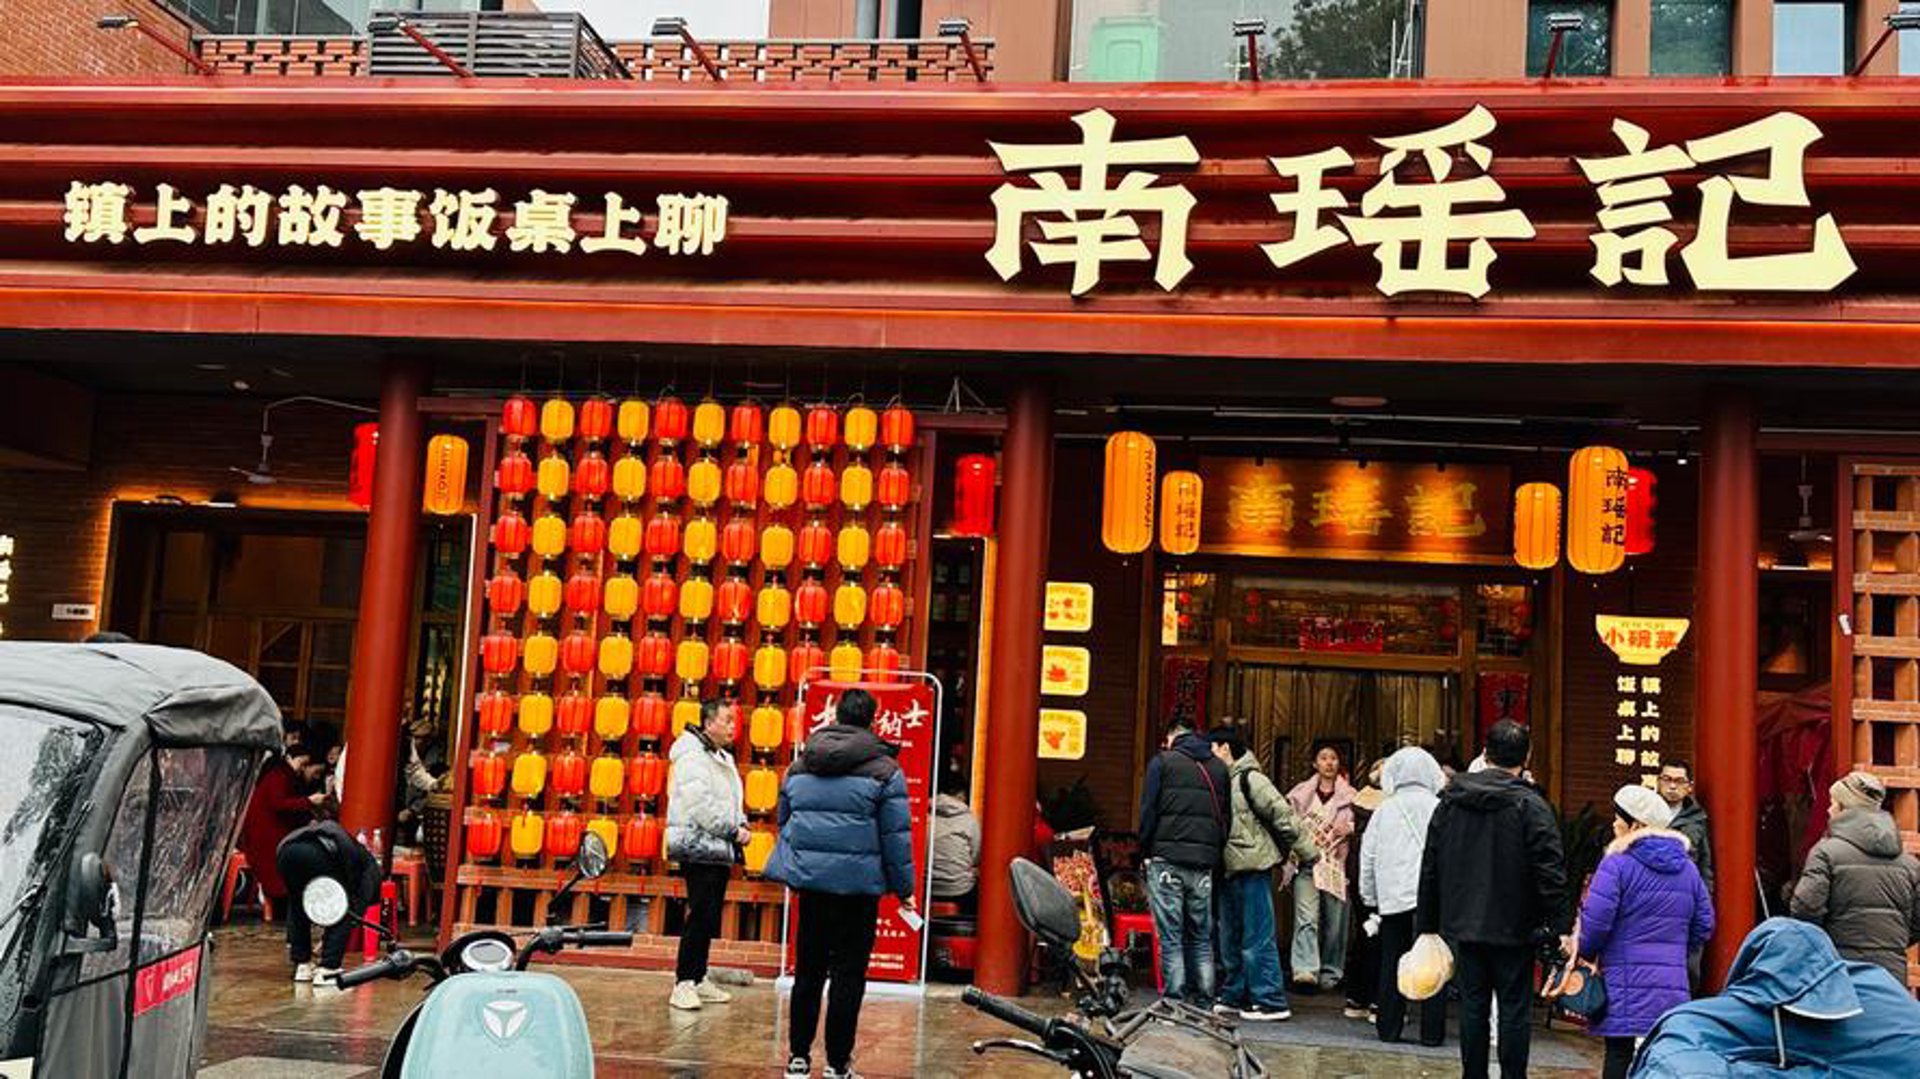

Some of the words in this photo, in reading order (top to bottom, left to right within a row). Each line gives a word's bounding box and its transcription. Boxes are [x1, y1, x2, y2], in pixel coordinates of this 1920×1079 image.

[64, 181, 729, 256] 镇上的故事饭桌上聊
[984, 103, 1859, 299] 南瑶記
[1604, 628, 1678, 650] 小碗菜
[1614, 675, 1637, 766] 饭桌上聊
